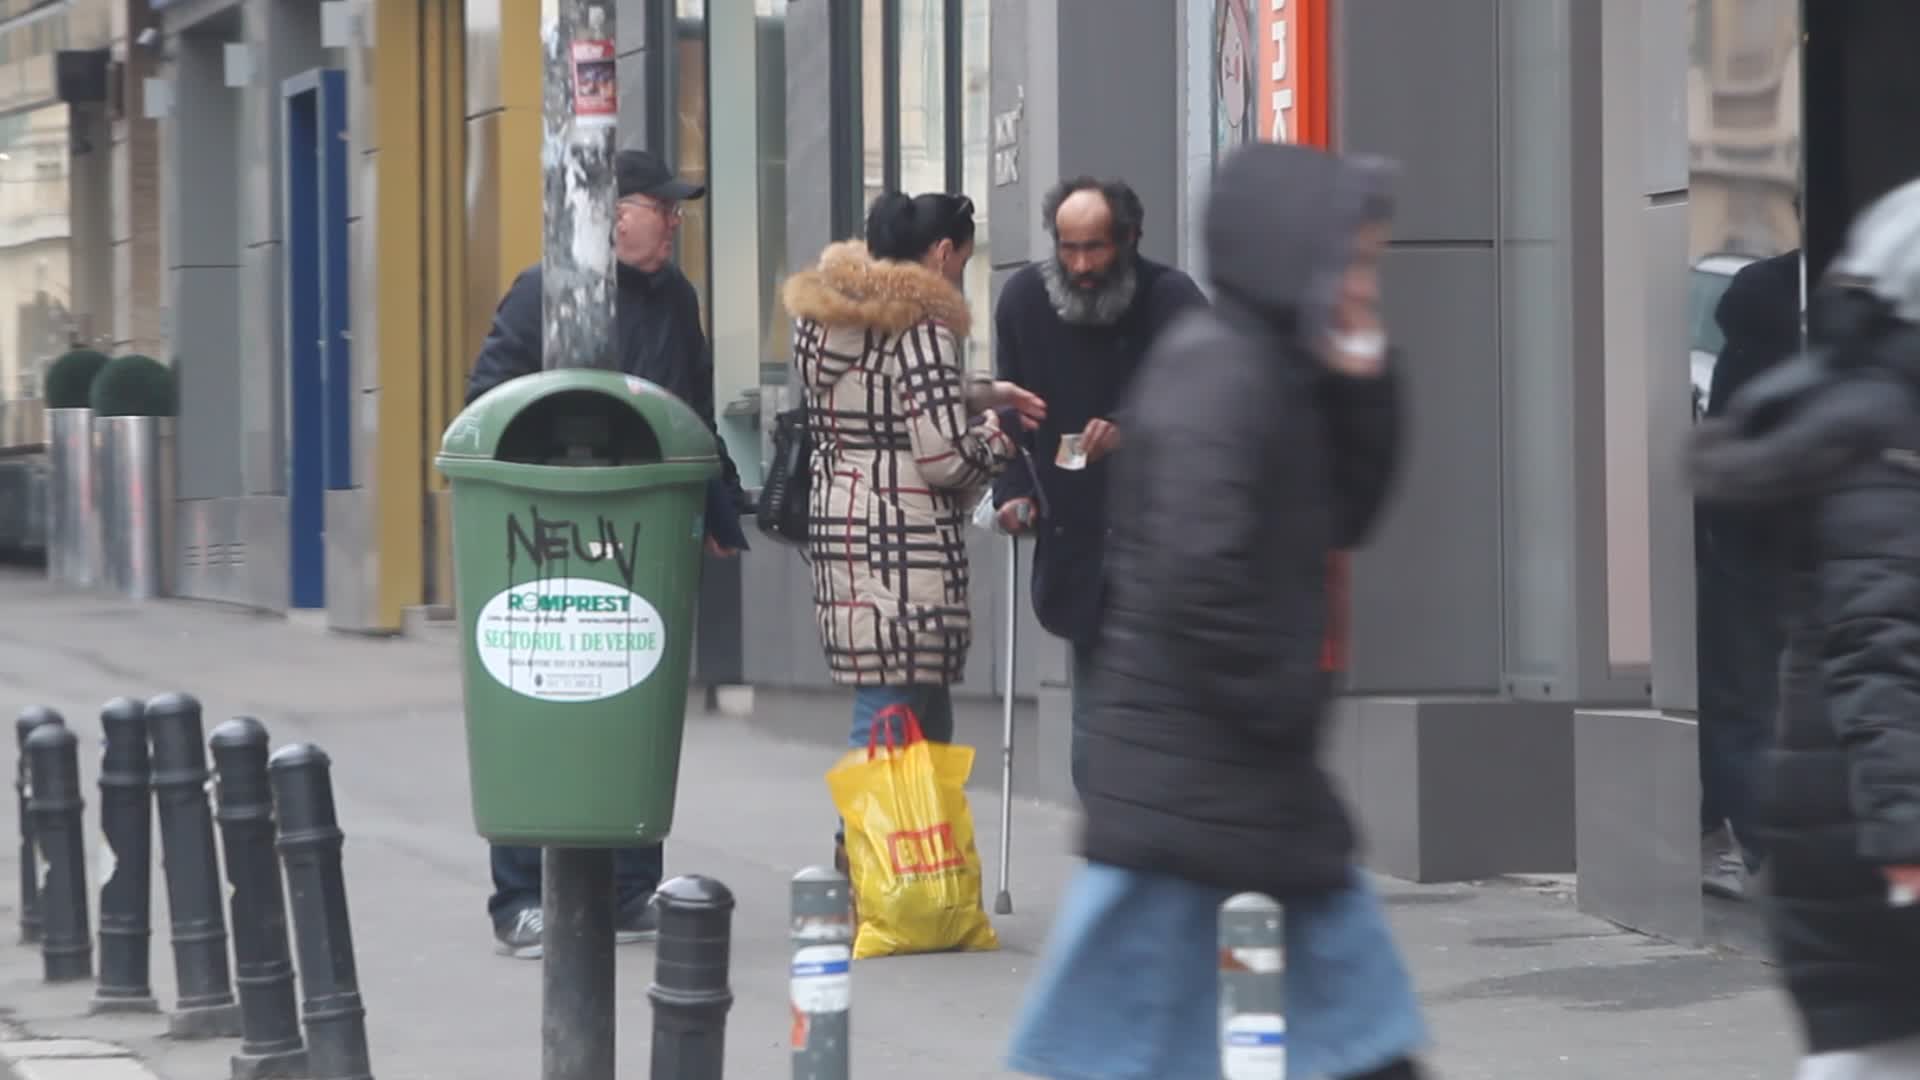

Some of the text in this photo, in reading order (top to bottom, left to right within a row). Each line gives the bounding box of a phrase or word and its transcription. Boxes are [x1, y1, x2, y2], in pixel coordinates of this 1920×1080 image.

[1271, 0, 1293, 144] nk
[508, 593, 630, 612] ROMPREST
[484, 629, 565, 651] SECTORUL
[581, 632, 604, 651] DE
[605, 631, 657, 652] VERDE
